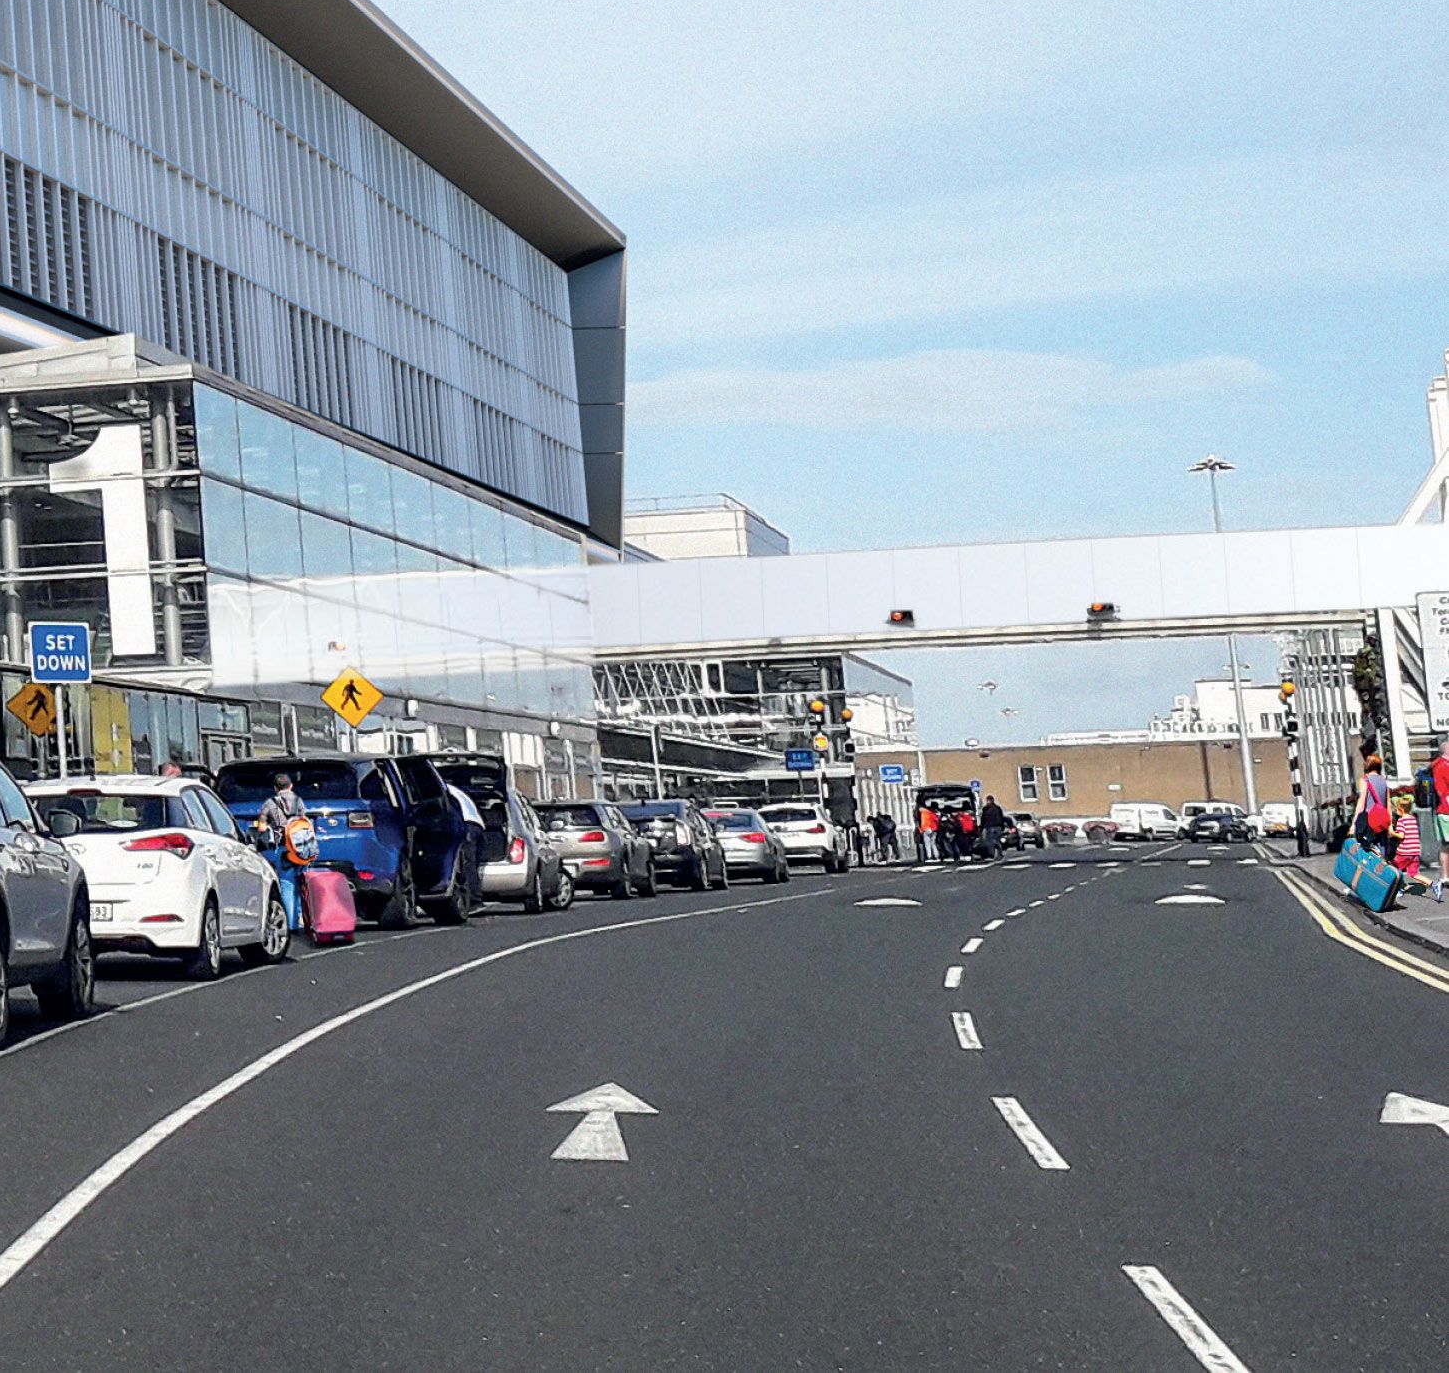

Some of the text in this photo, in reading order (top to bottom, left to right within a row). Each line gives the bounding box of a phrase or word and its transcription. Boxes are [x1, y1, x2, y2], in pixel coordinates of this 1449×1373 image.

[49, 425, 156, 656] 1
[45, 634, 75, 651] SET
[37, 654, 86, 671] DOWN
